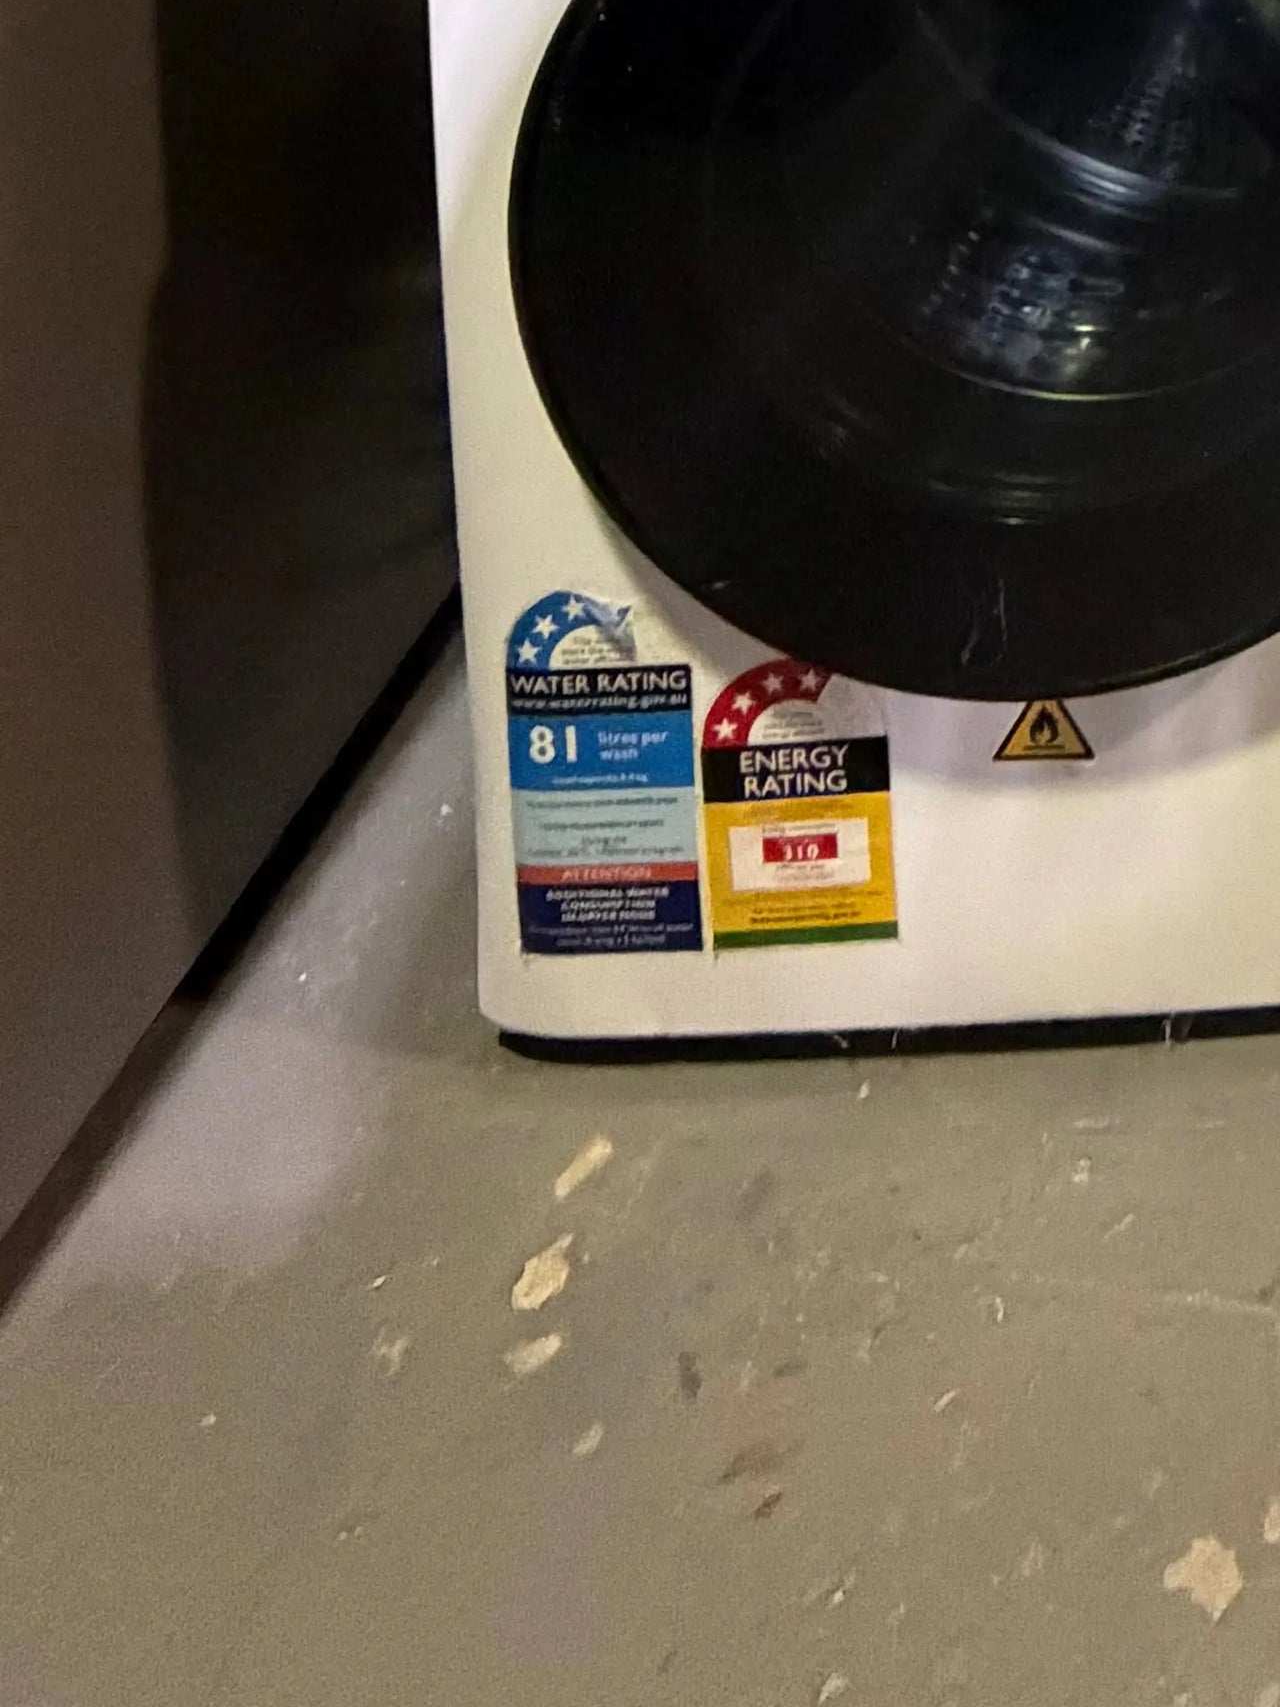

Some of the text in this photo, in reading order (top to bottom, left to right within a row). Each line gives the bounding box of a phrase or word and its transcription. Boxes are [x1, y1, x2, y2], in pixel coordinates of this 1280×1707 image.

[511, 670, 687, 696] WATER RATING
[529, 725, 578, 764] 81
[739, 743, 849, 774] ENERGY
[744, 770, 848, 799] RATING
